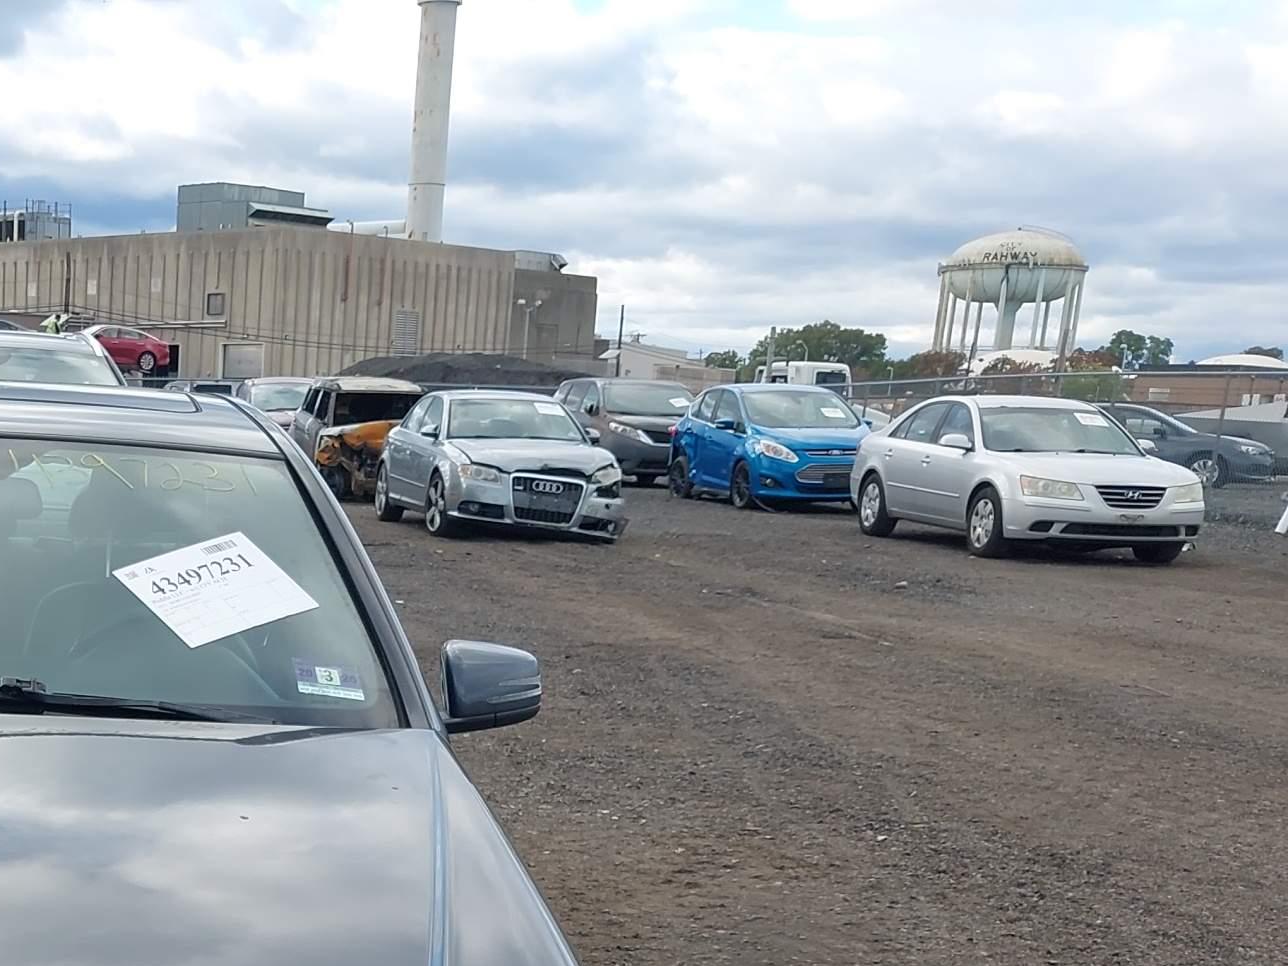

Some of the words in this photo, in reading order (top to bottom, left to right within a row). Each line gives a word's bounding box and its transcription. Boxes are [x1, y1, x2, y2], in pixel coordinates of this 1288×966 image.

[982, 251, 1038, 262] RAHWAY
[151, 553, 254, 596] 43497231
[324, 670, 334, 682] 3
